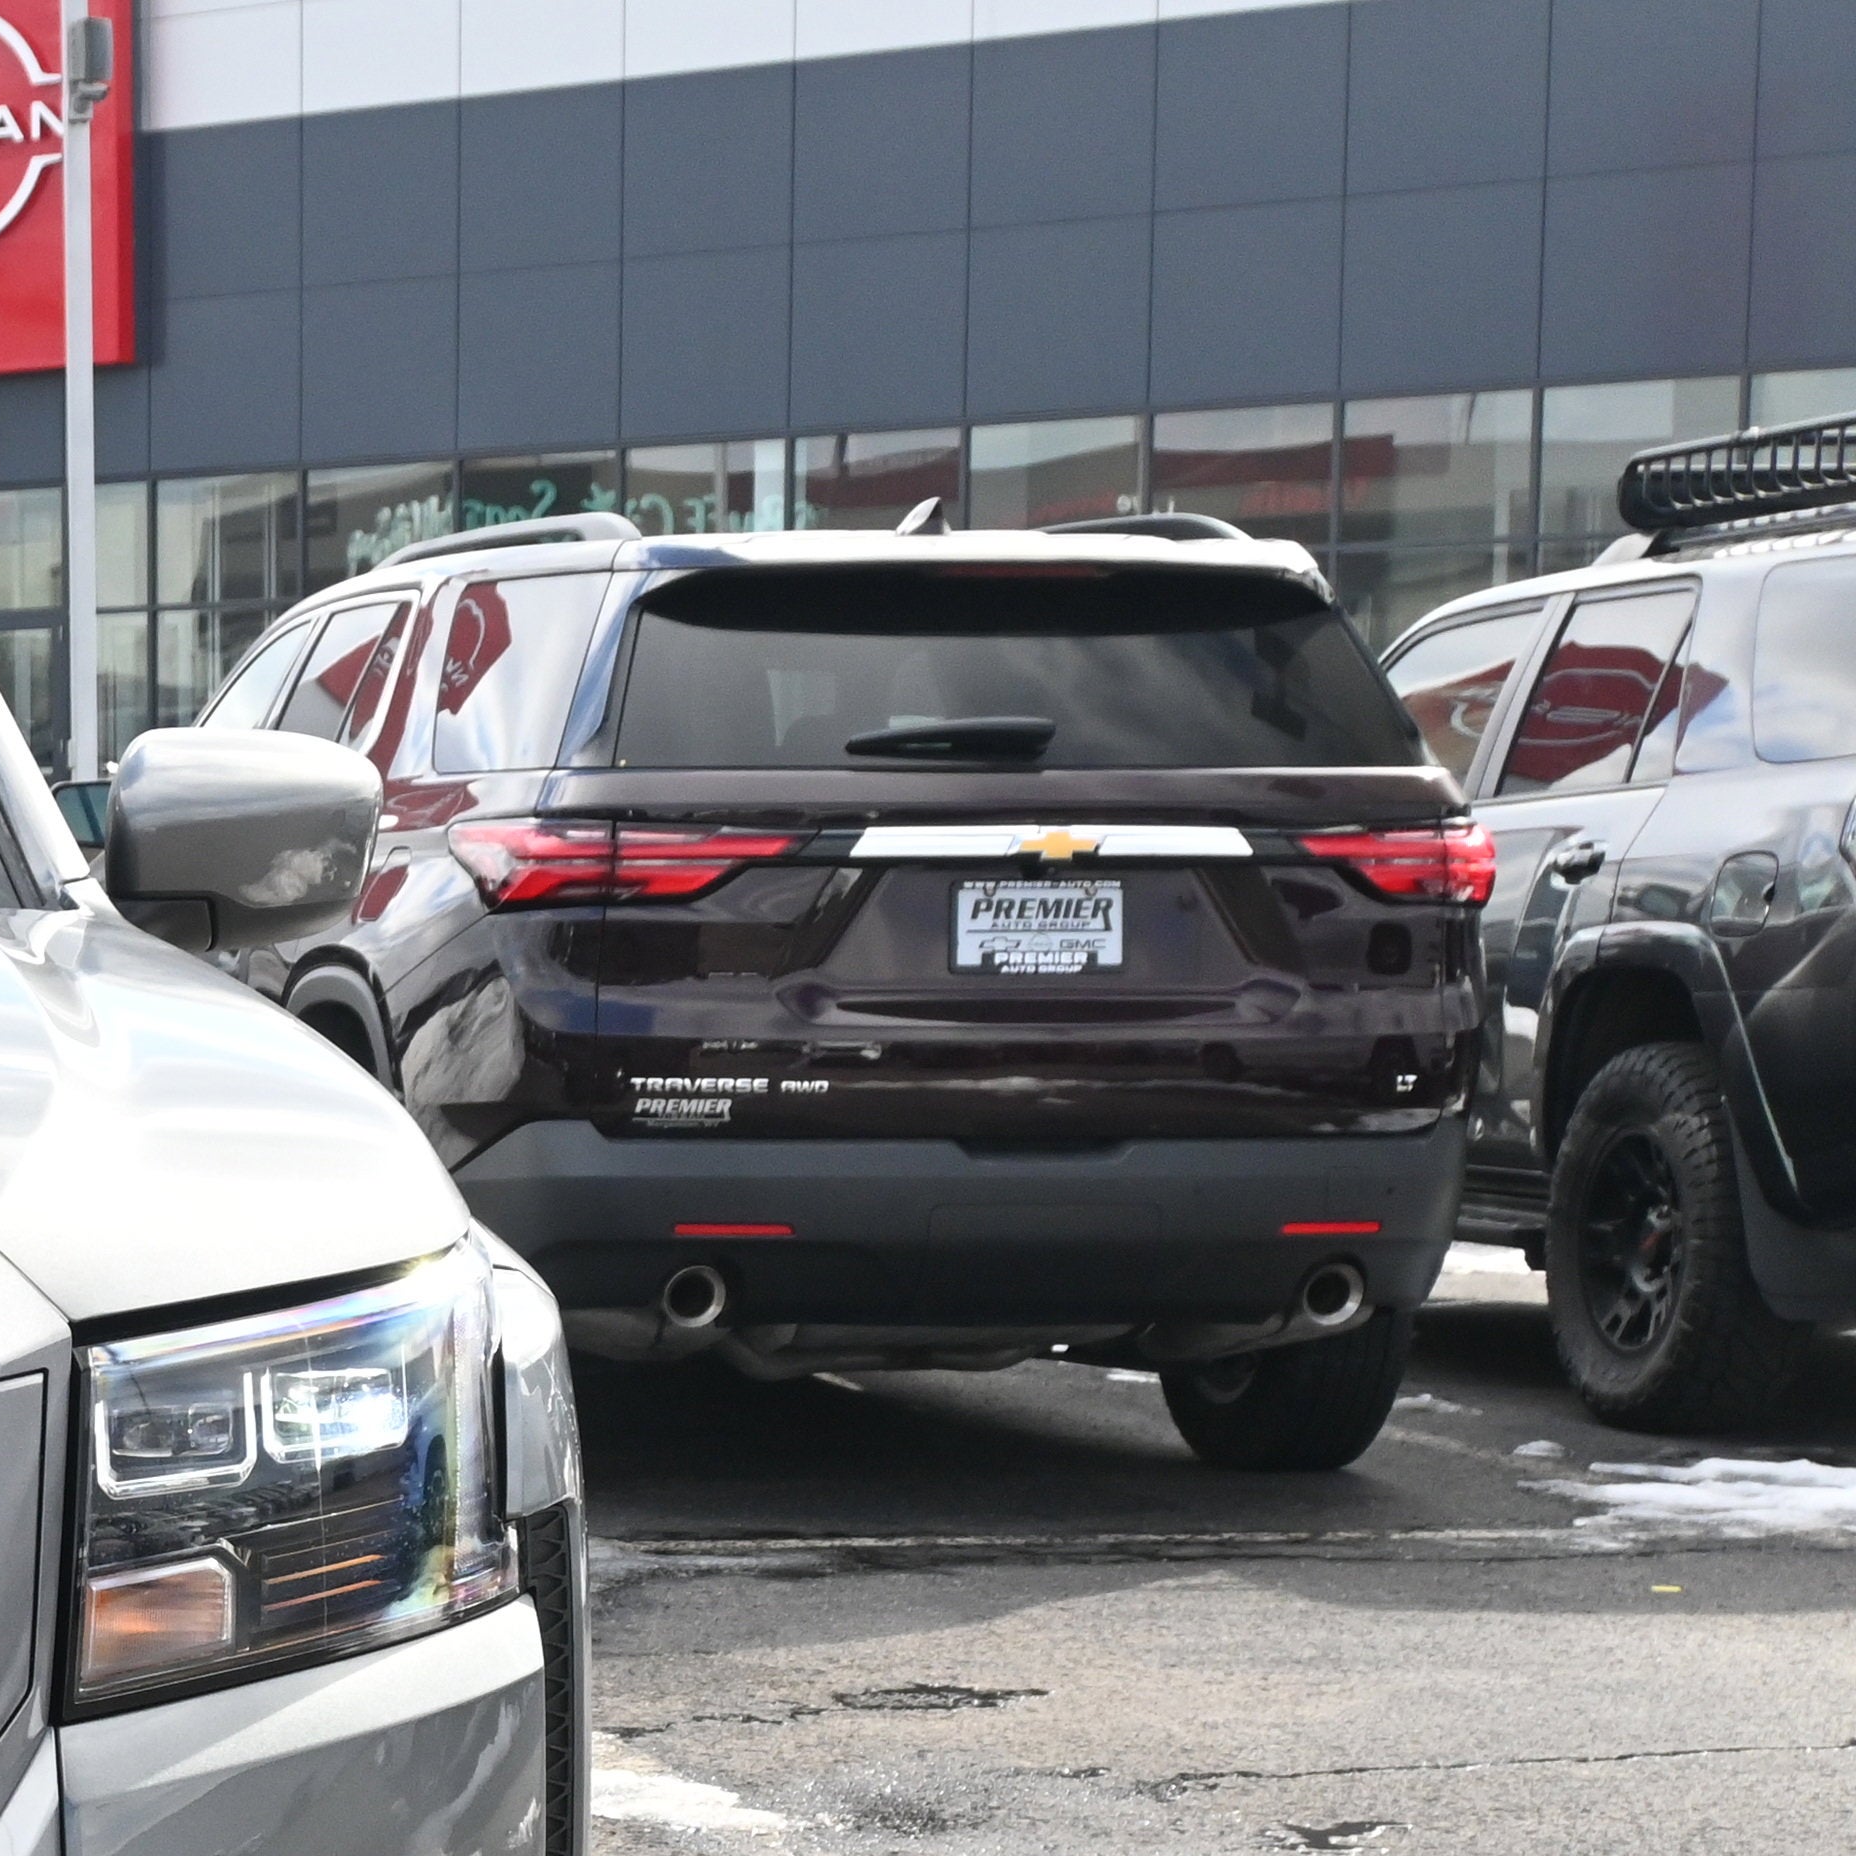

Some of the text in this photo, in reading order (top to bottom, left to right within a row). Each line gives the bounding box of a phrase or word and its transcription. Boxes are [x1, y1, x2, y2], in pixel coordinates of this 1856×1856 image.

[970, 897, 1114, 931] PREMIER
[991, 920, 1091, 928] AUTO GROUP
[1059, 938, 1107, 949] GMC
[994, 951, 1088, 964] PREMIER
[1000, 964, 1084, 974] AUTO GROUP
[630, 1077, 830, 1094] TRAVERSE AWD
[634, 1098, 732, 1121] PREMIER
